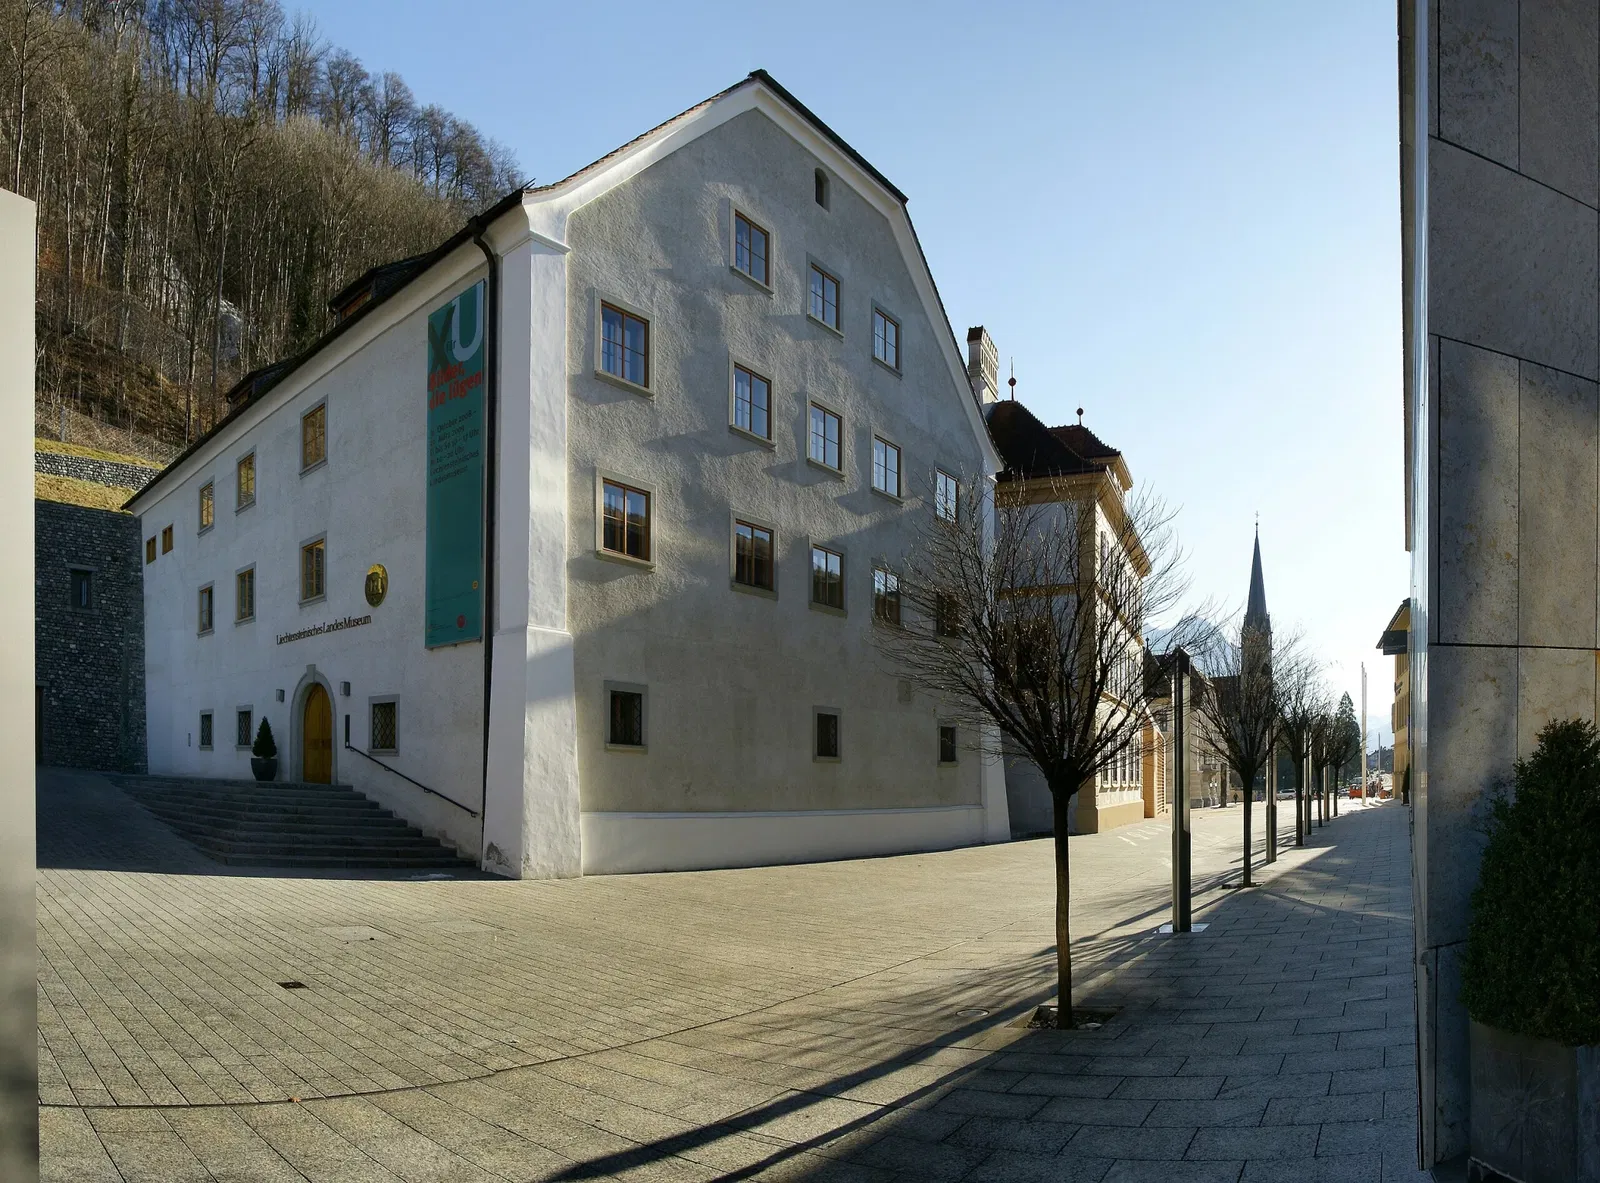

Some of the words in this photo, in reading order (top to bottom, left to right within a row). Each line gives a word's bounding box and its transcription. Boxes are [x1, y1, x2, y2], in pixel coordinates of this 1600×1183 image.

[452, 280, 483, 361] U
[429, 390, 445, 411] die
[437, 417, 457, 433] Oktober
[276, 625, 322, 645] Liechtensteinisches
